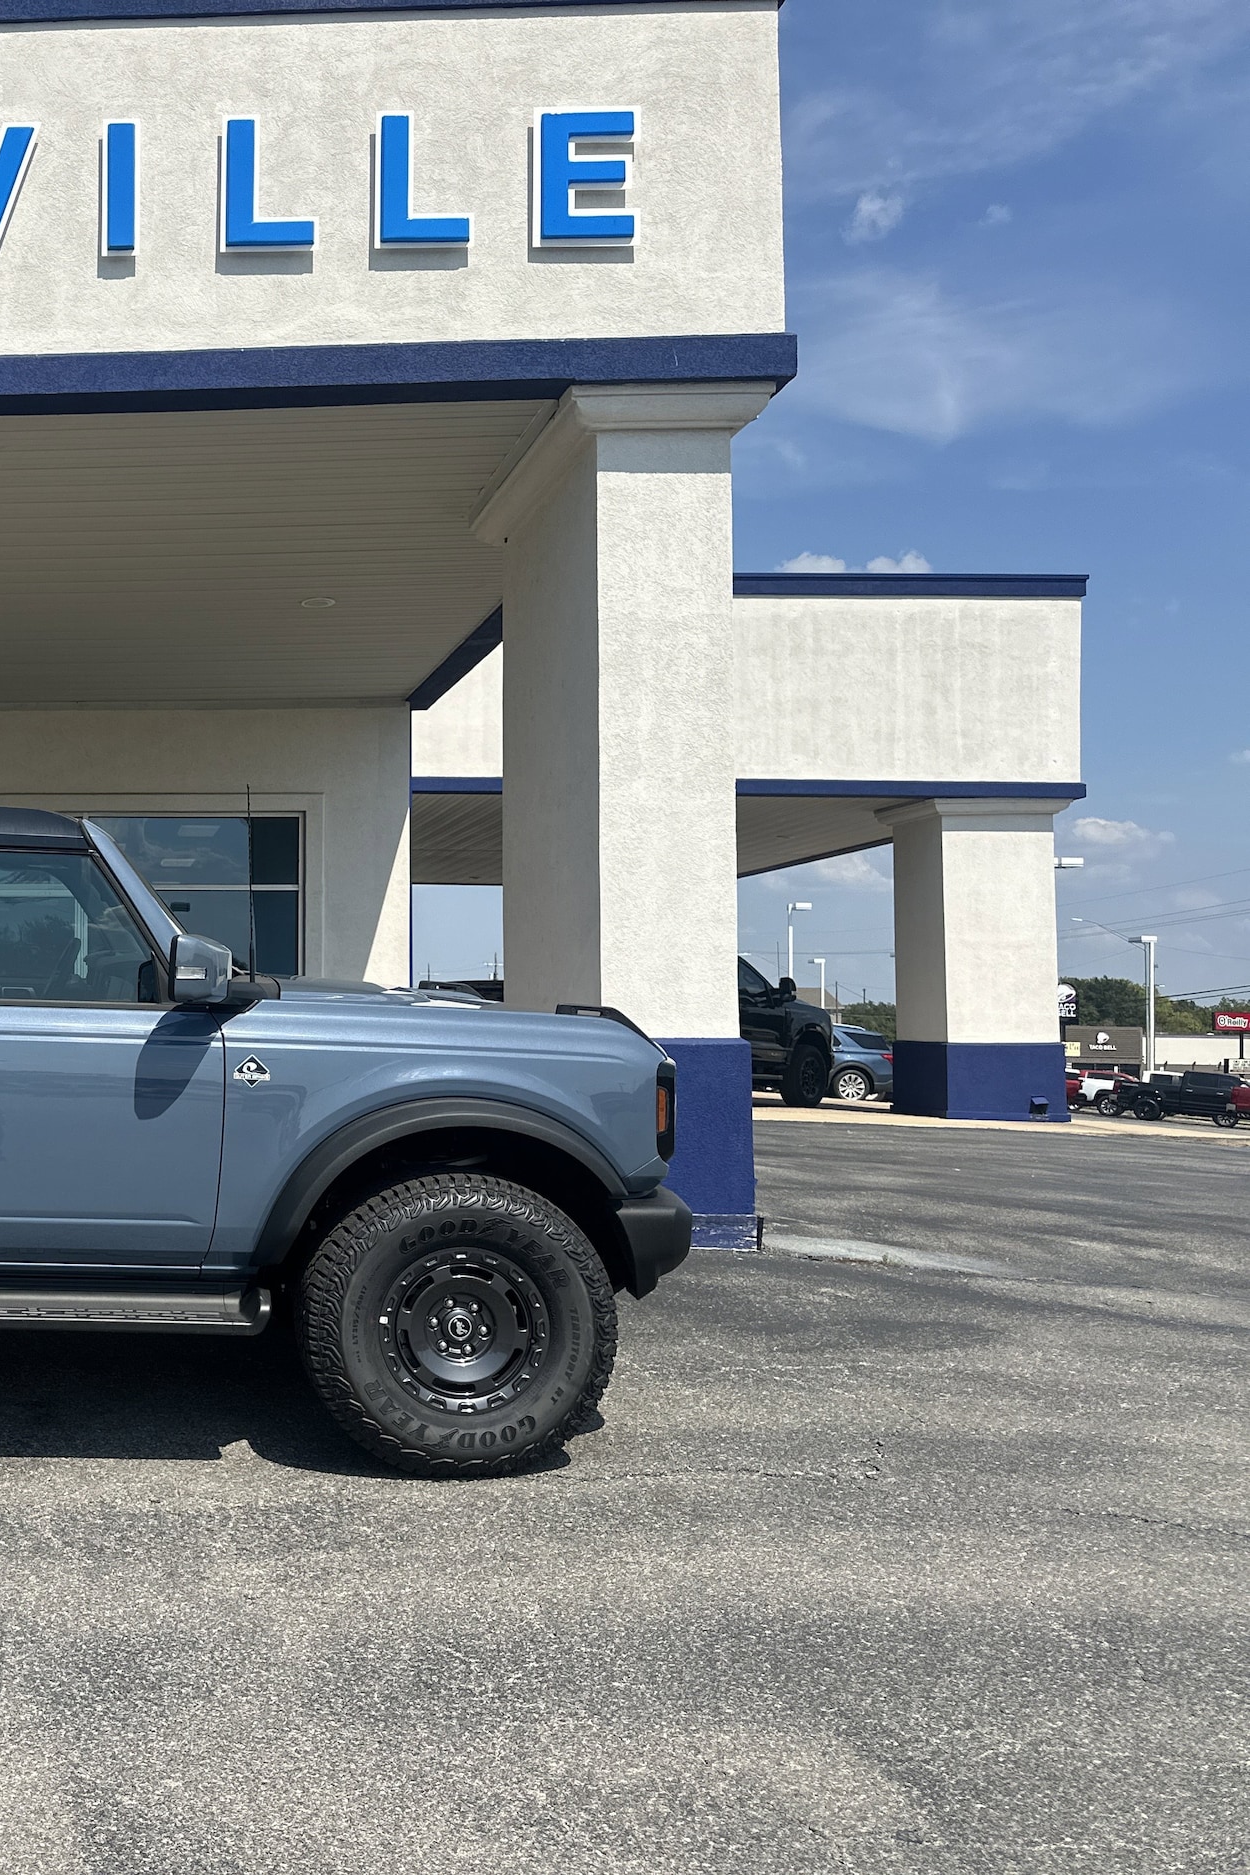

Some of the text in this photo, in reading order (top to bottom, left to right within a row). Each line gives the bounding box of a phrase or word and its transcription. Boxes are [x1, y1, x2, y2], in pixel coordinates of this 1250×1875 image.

[1218, 1015, 1248, 1028] O'Reilly
[398, 1218, 571, 1291] GOODYEAR
[363, 1378, 537, 1451] GOODYEAR
